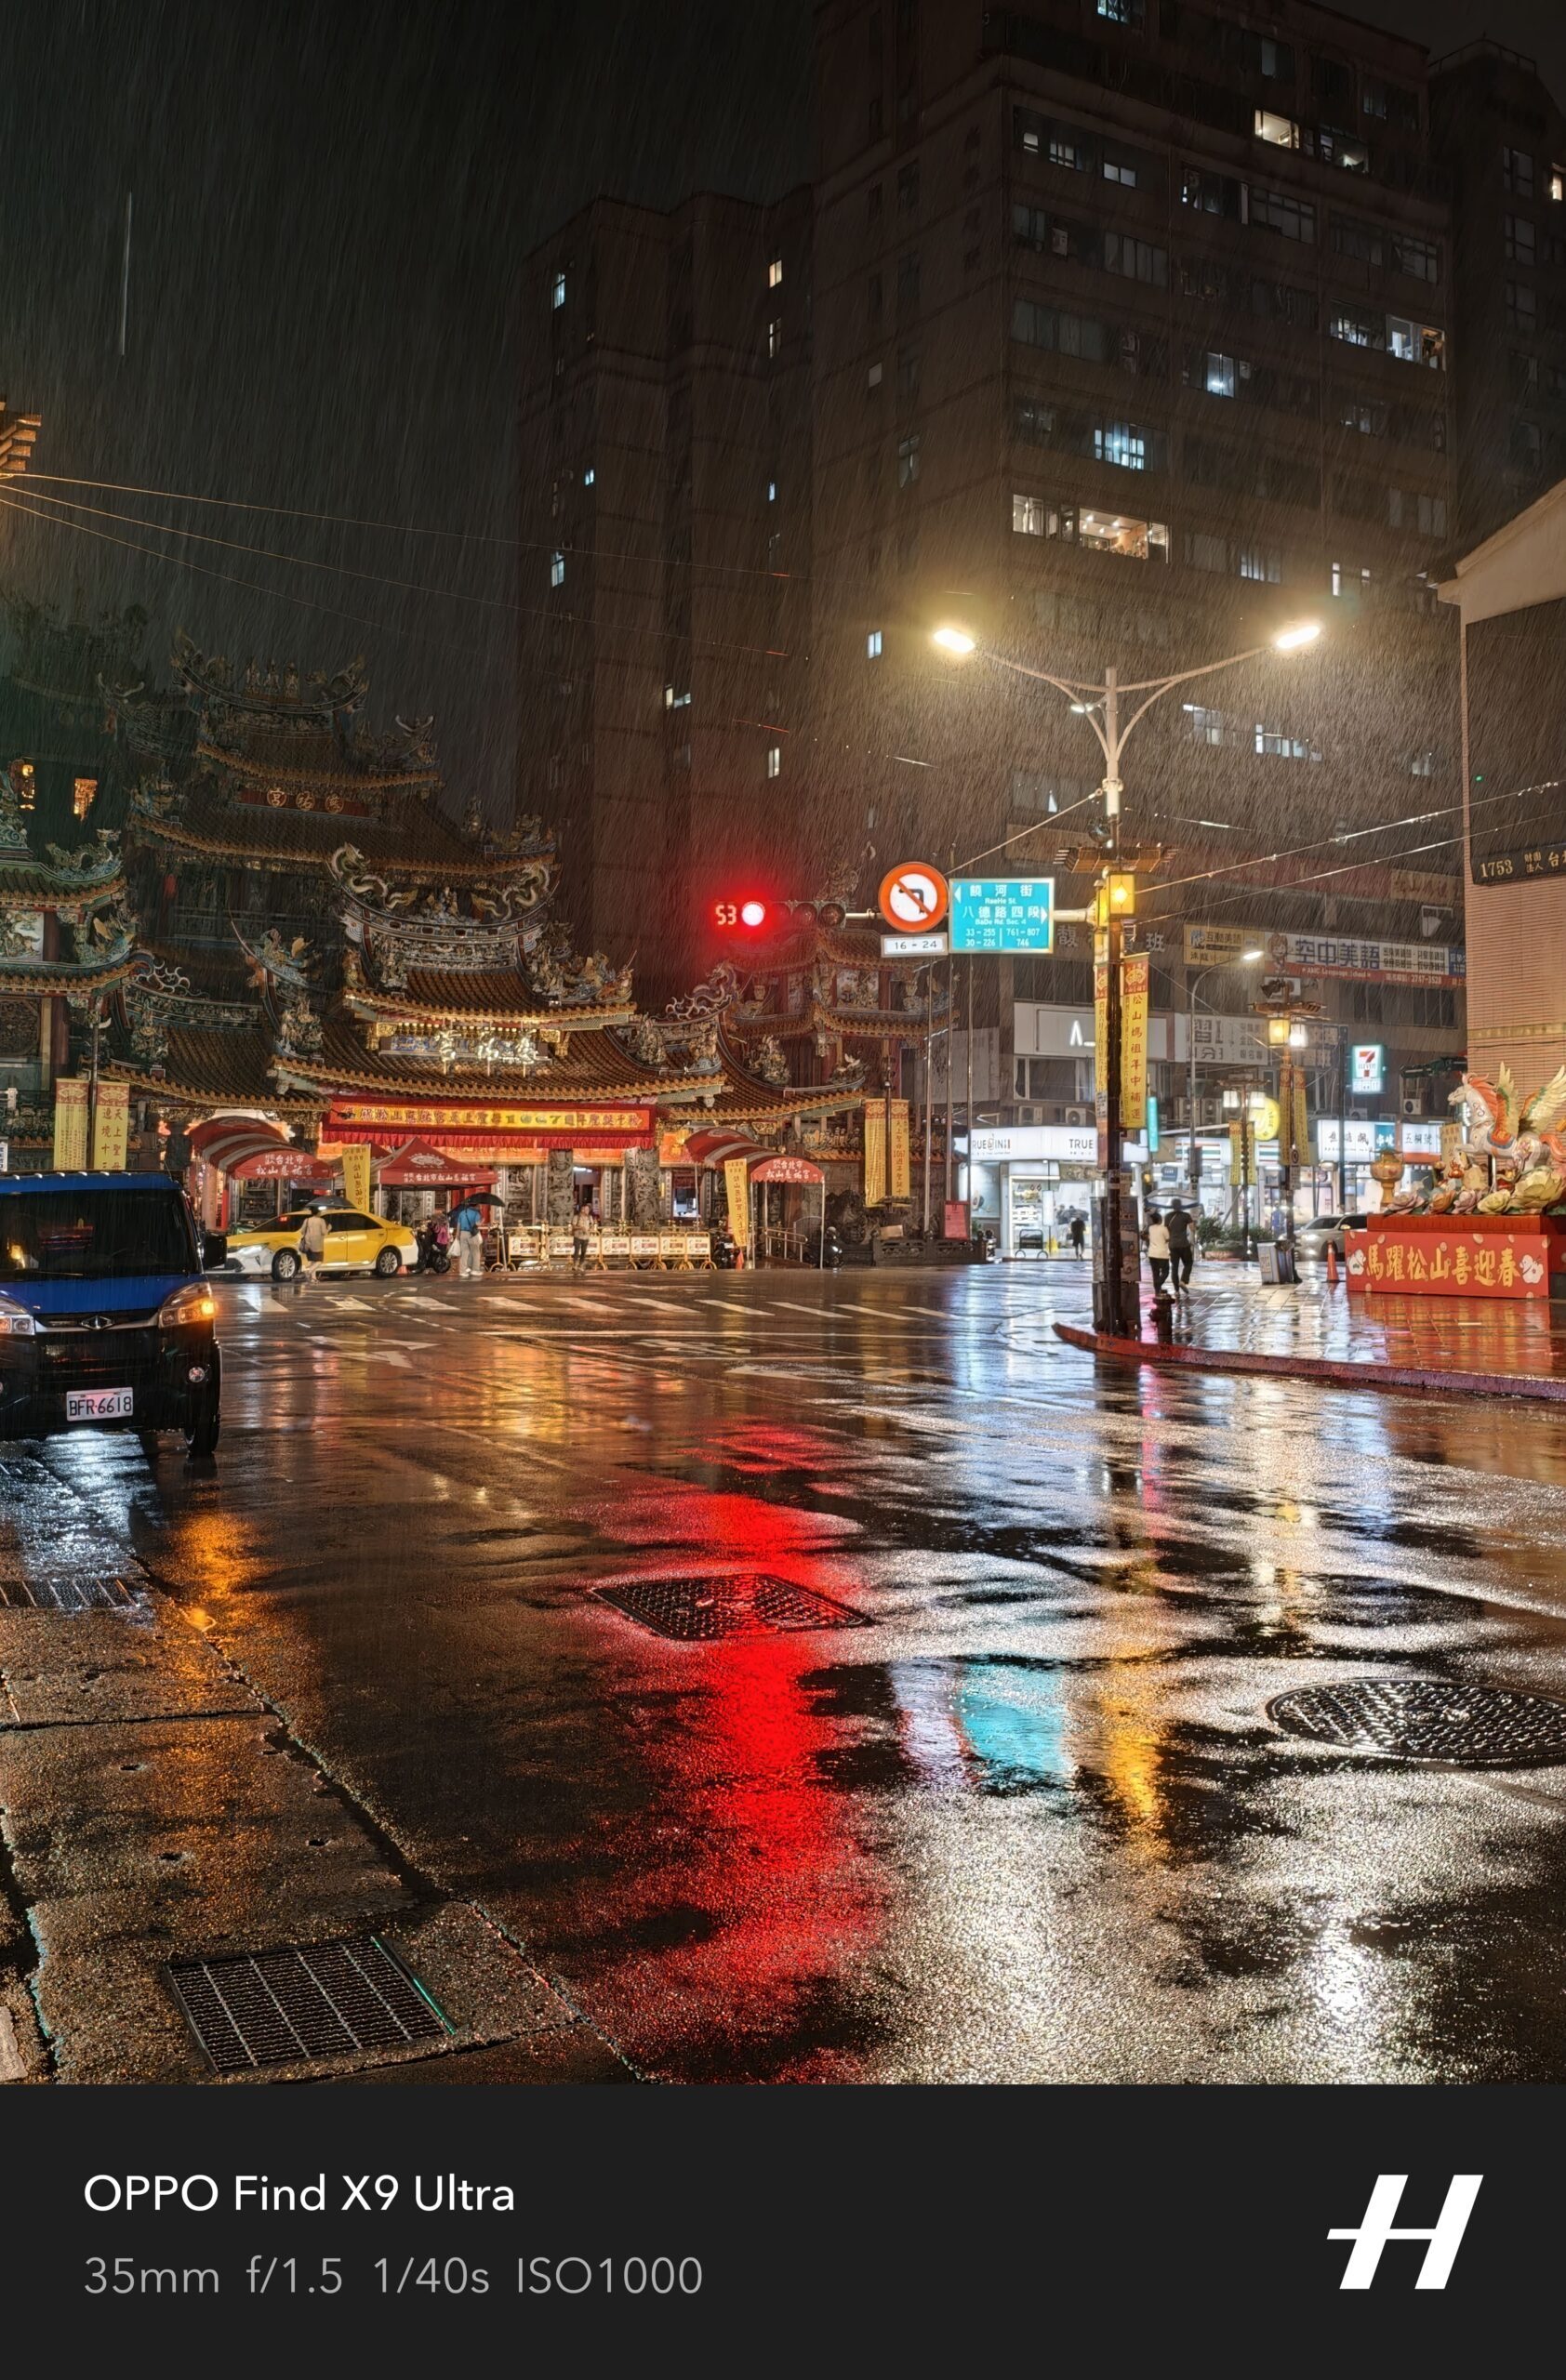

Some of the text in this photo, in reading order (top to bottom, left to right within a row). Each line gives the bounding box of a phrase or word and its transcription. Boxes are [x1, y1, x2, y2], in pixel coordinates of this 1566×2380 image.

[1480, 858, 1514, 878] 1753
[1548, 850, 1566, 867] 台
[714, 905, 737, 925] 53
[962, 906, 1040, 919] 八德路四段
[1295, 939, 1380, 970] 空中美語
[1366, 1243, 1521, 1288] 馬躍松山喜迎春
